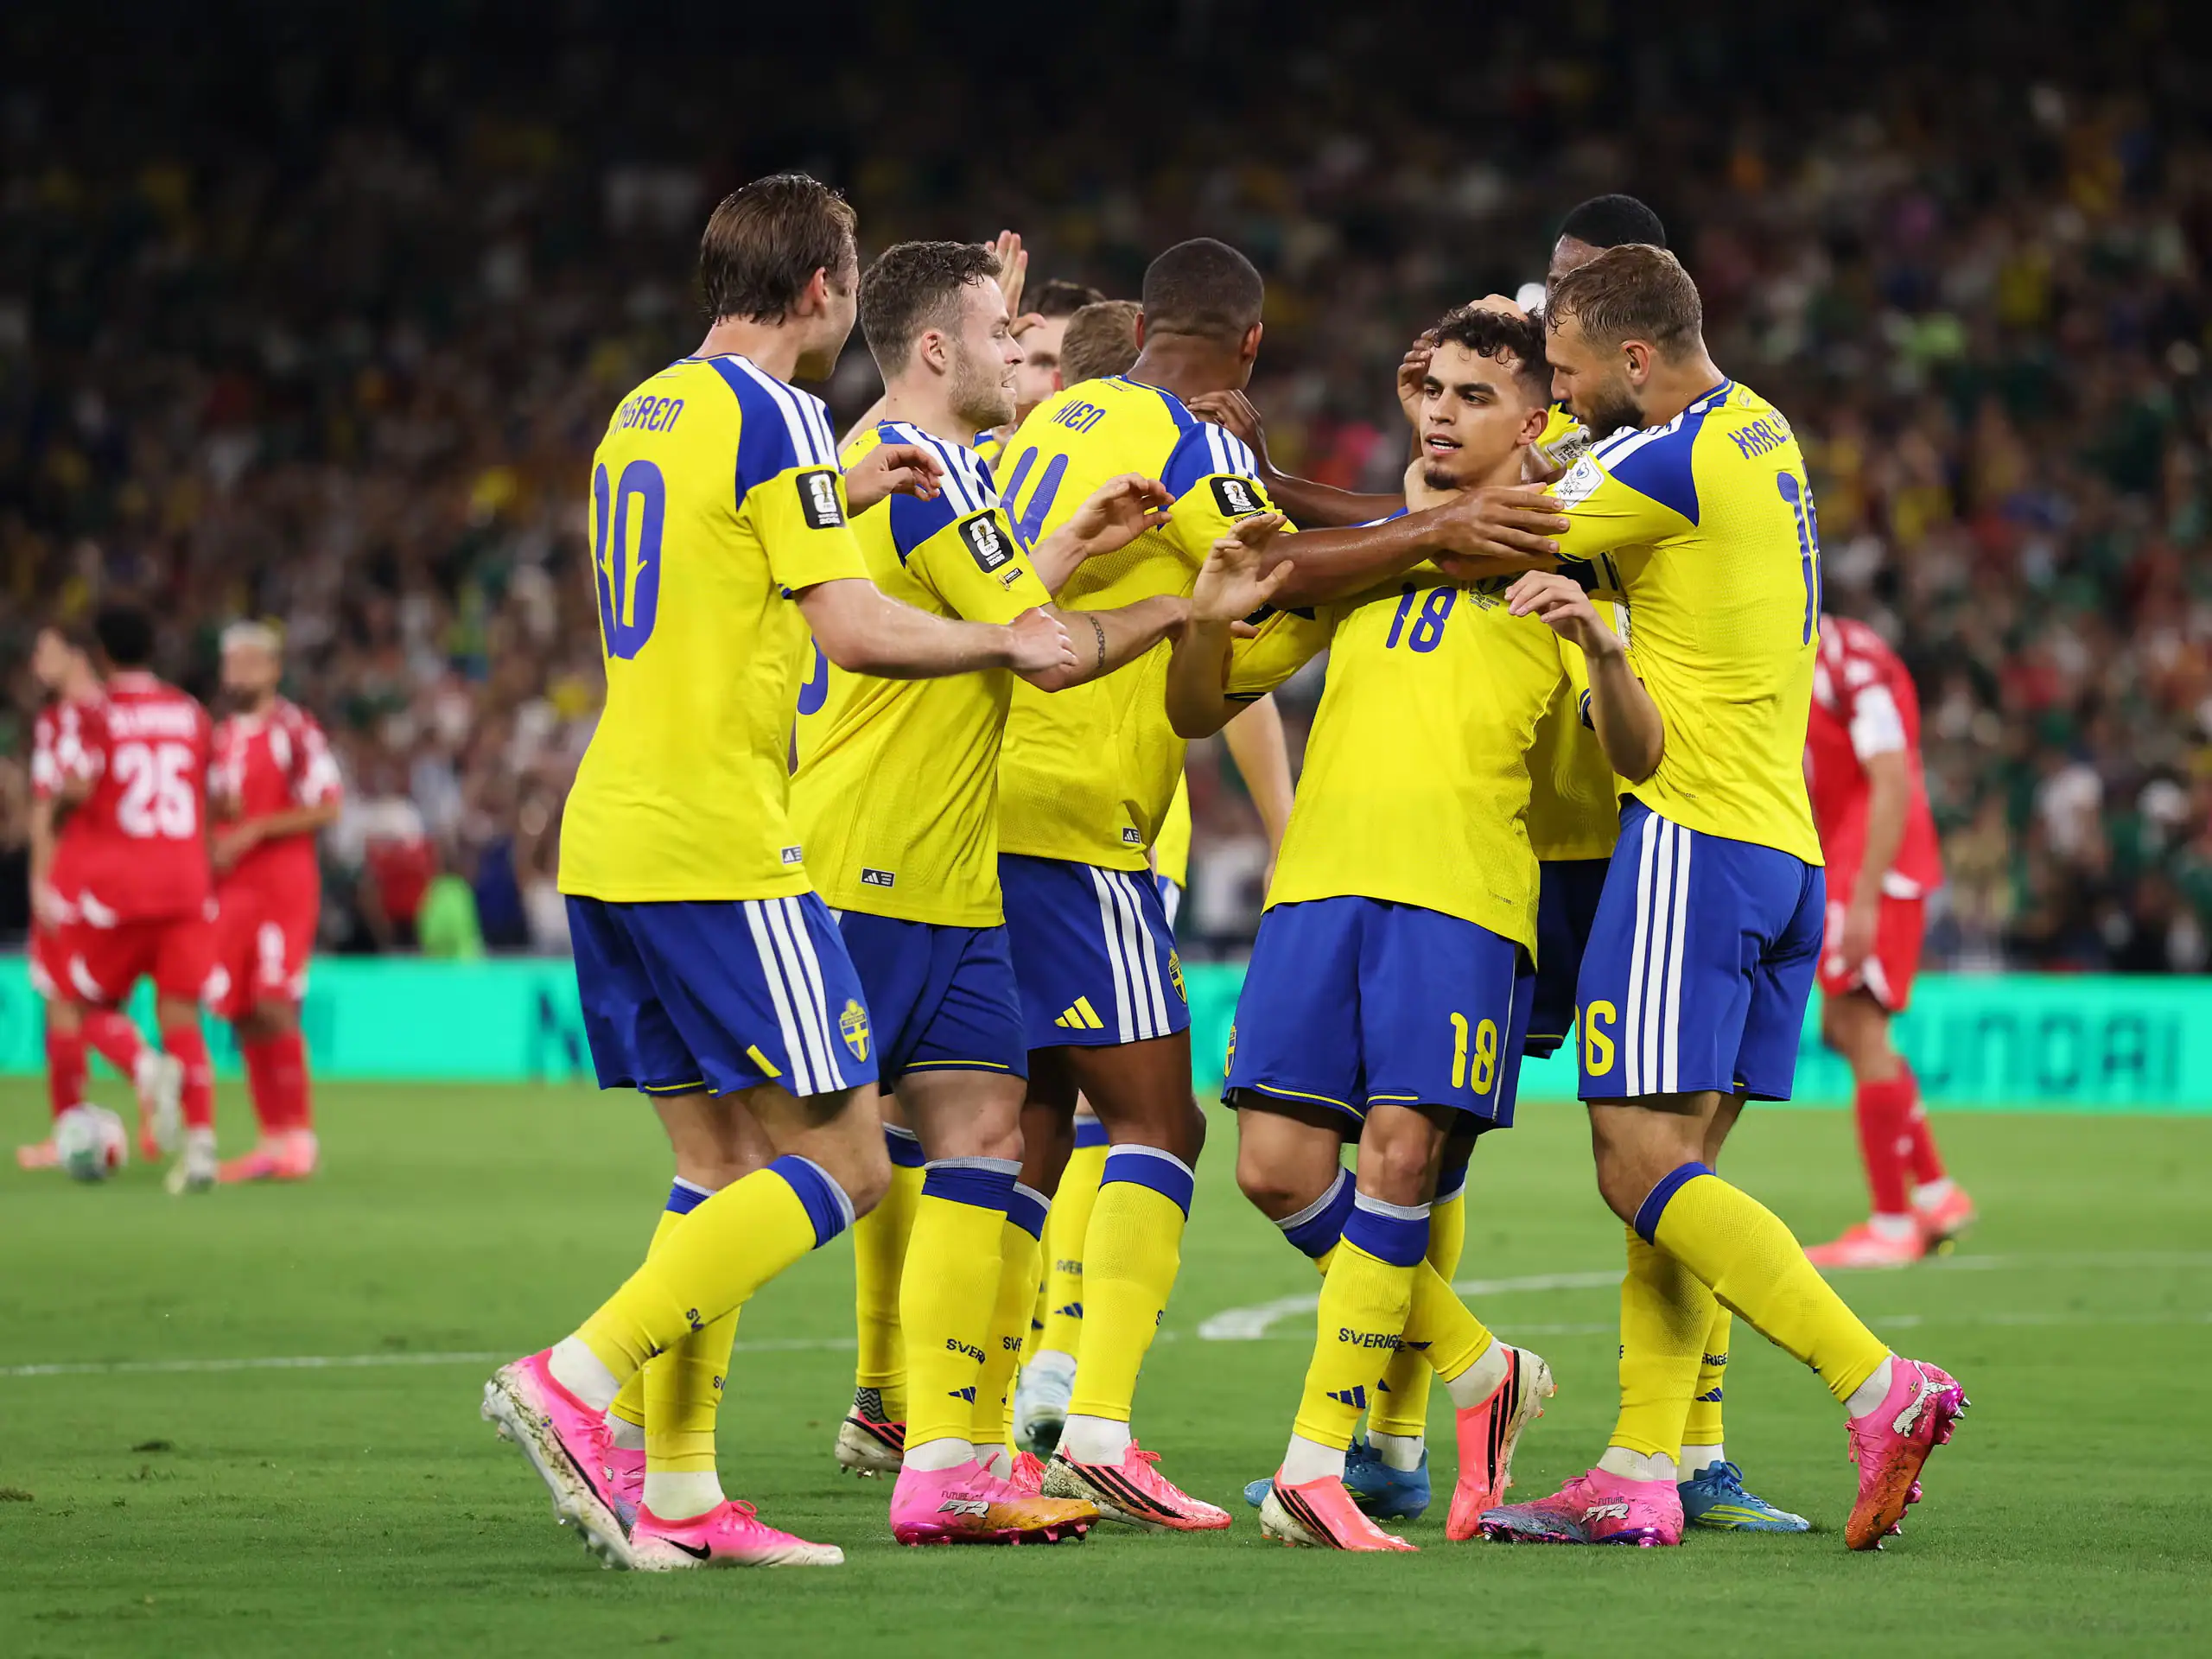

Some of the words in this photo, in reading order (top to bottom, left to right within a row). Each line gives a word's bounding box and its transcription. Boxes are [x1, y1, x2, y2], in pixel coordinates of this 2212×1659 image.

[1049, 399, 1106, 434] HIEN
[1386, 582, 1458, 653] 18
[1450, 1012, 1497, 1096] 18
[1575, 1000, 1617, 1077] 6
